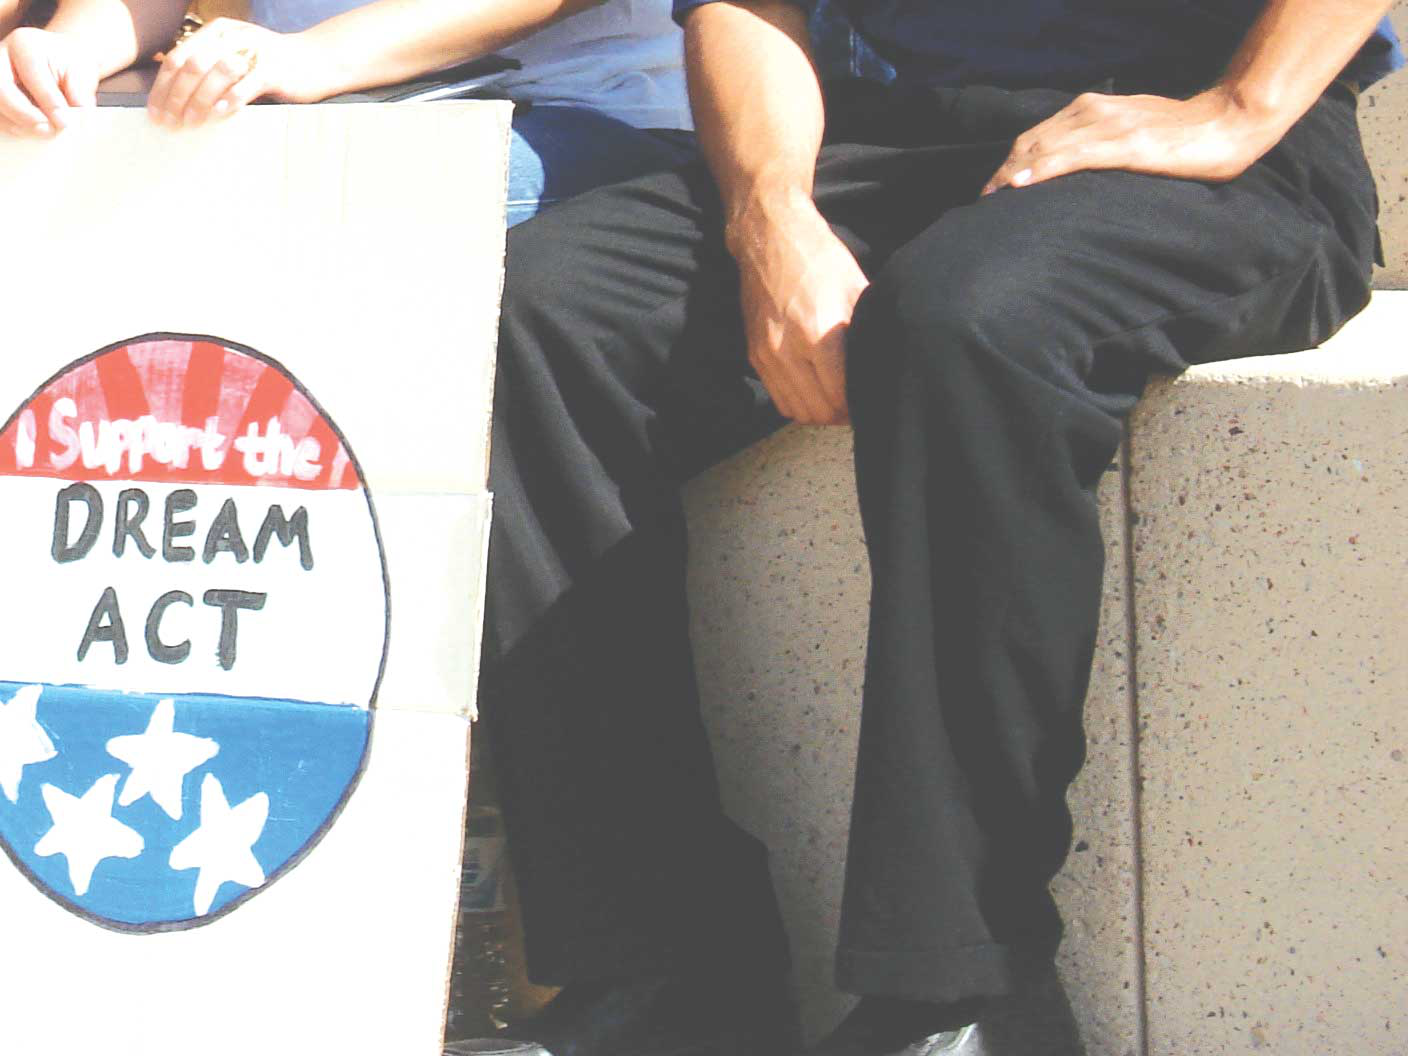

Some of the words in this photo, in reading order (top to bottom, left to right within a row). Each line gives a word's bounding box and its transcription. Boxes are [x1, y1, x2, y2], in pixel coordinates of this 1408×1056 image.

[15, 409, 37, 466] I
[48, 396, 226, 474] Support
[233, 416, 326, 481] the
[51, 482, 314, 571] DREAM
[77, 586, 267, 671] ACT
